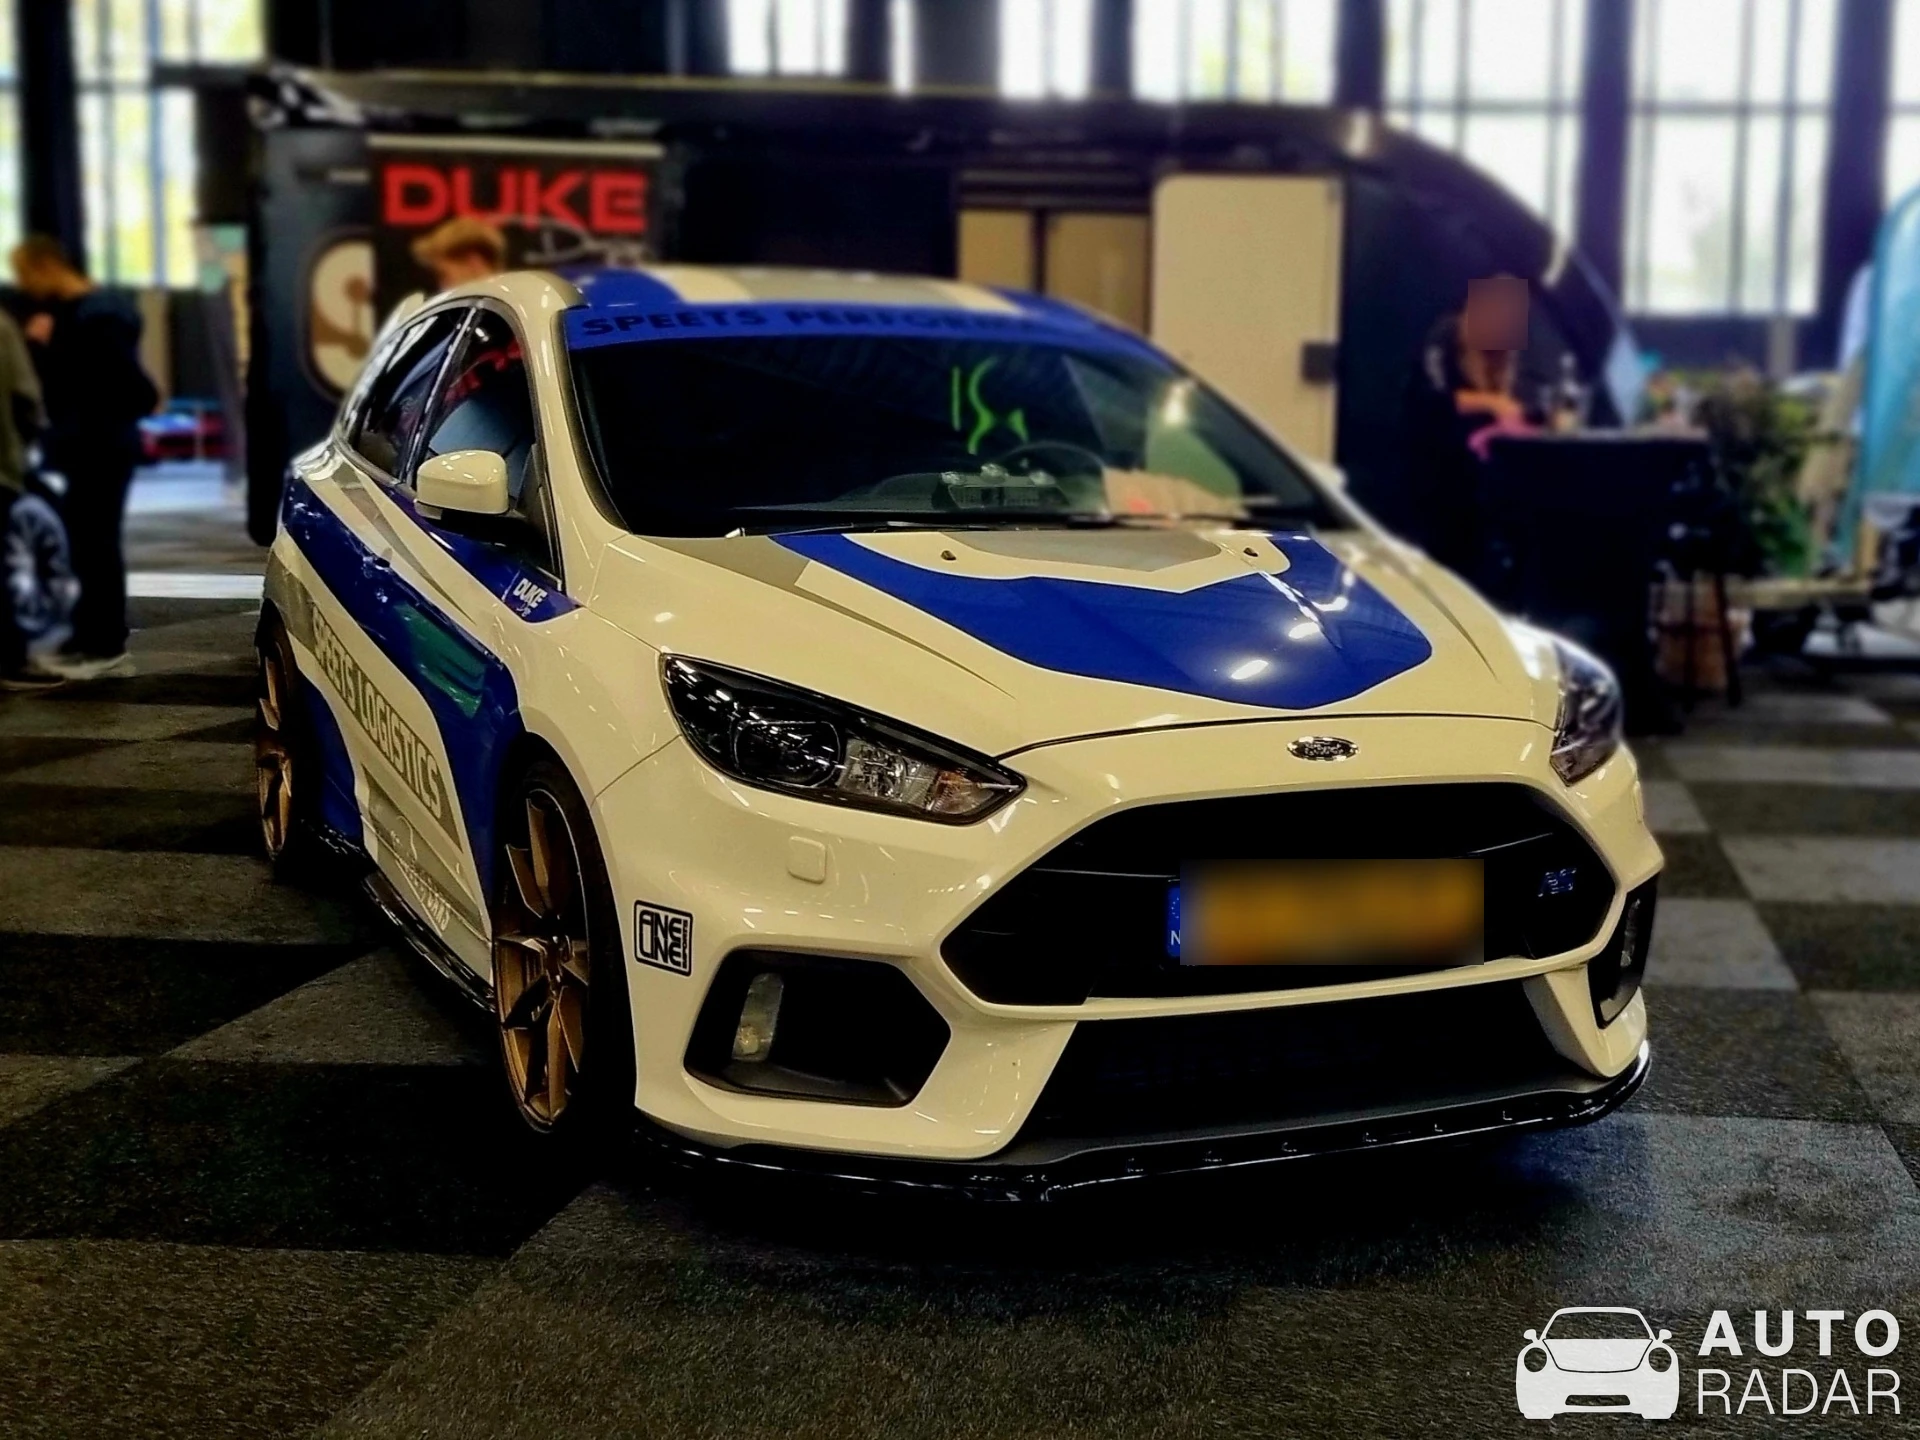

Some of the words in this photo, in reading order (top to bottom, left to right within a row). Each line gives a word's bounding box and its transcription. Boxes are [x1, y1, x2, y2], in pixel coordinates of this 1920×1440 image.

[384, 164, 647, 232] DUKE
[581, 309, 767, 335] SPEETS
[513, 578, 548, 608] DUKE
[356, 668, 442, 820] LOGISTICS
